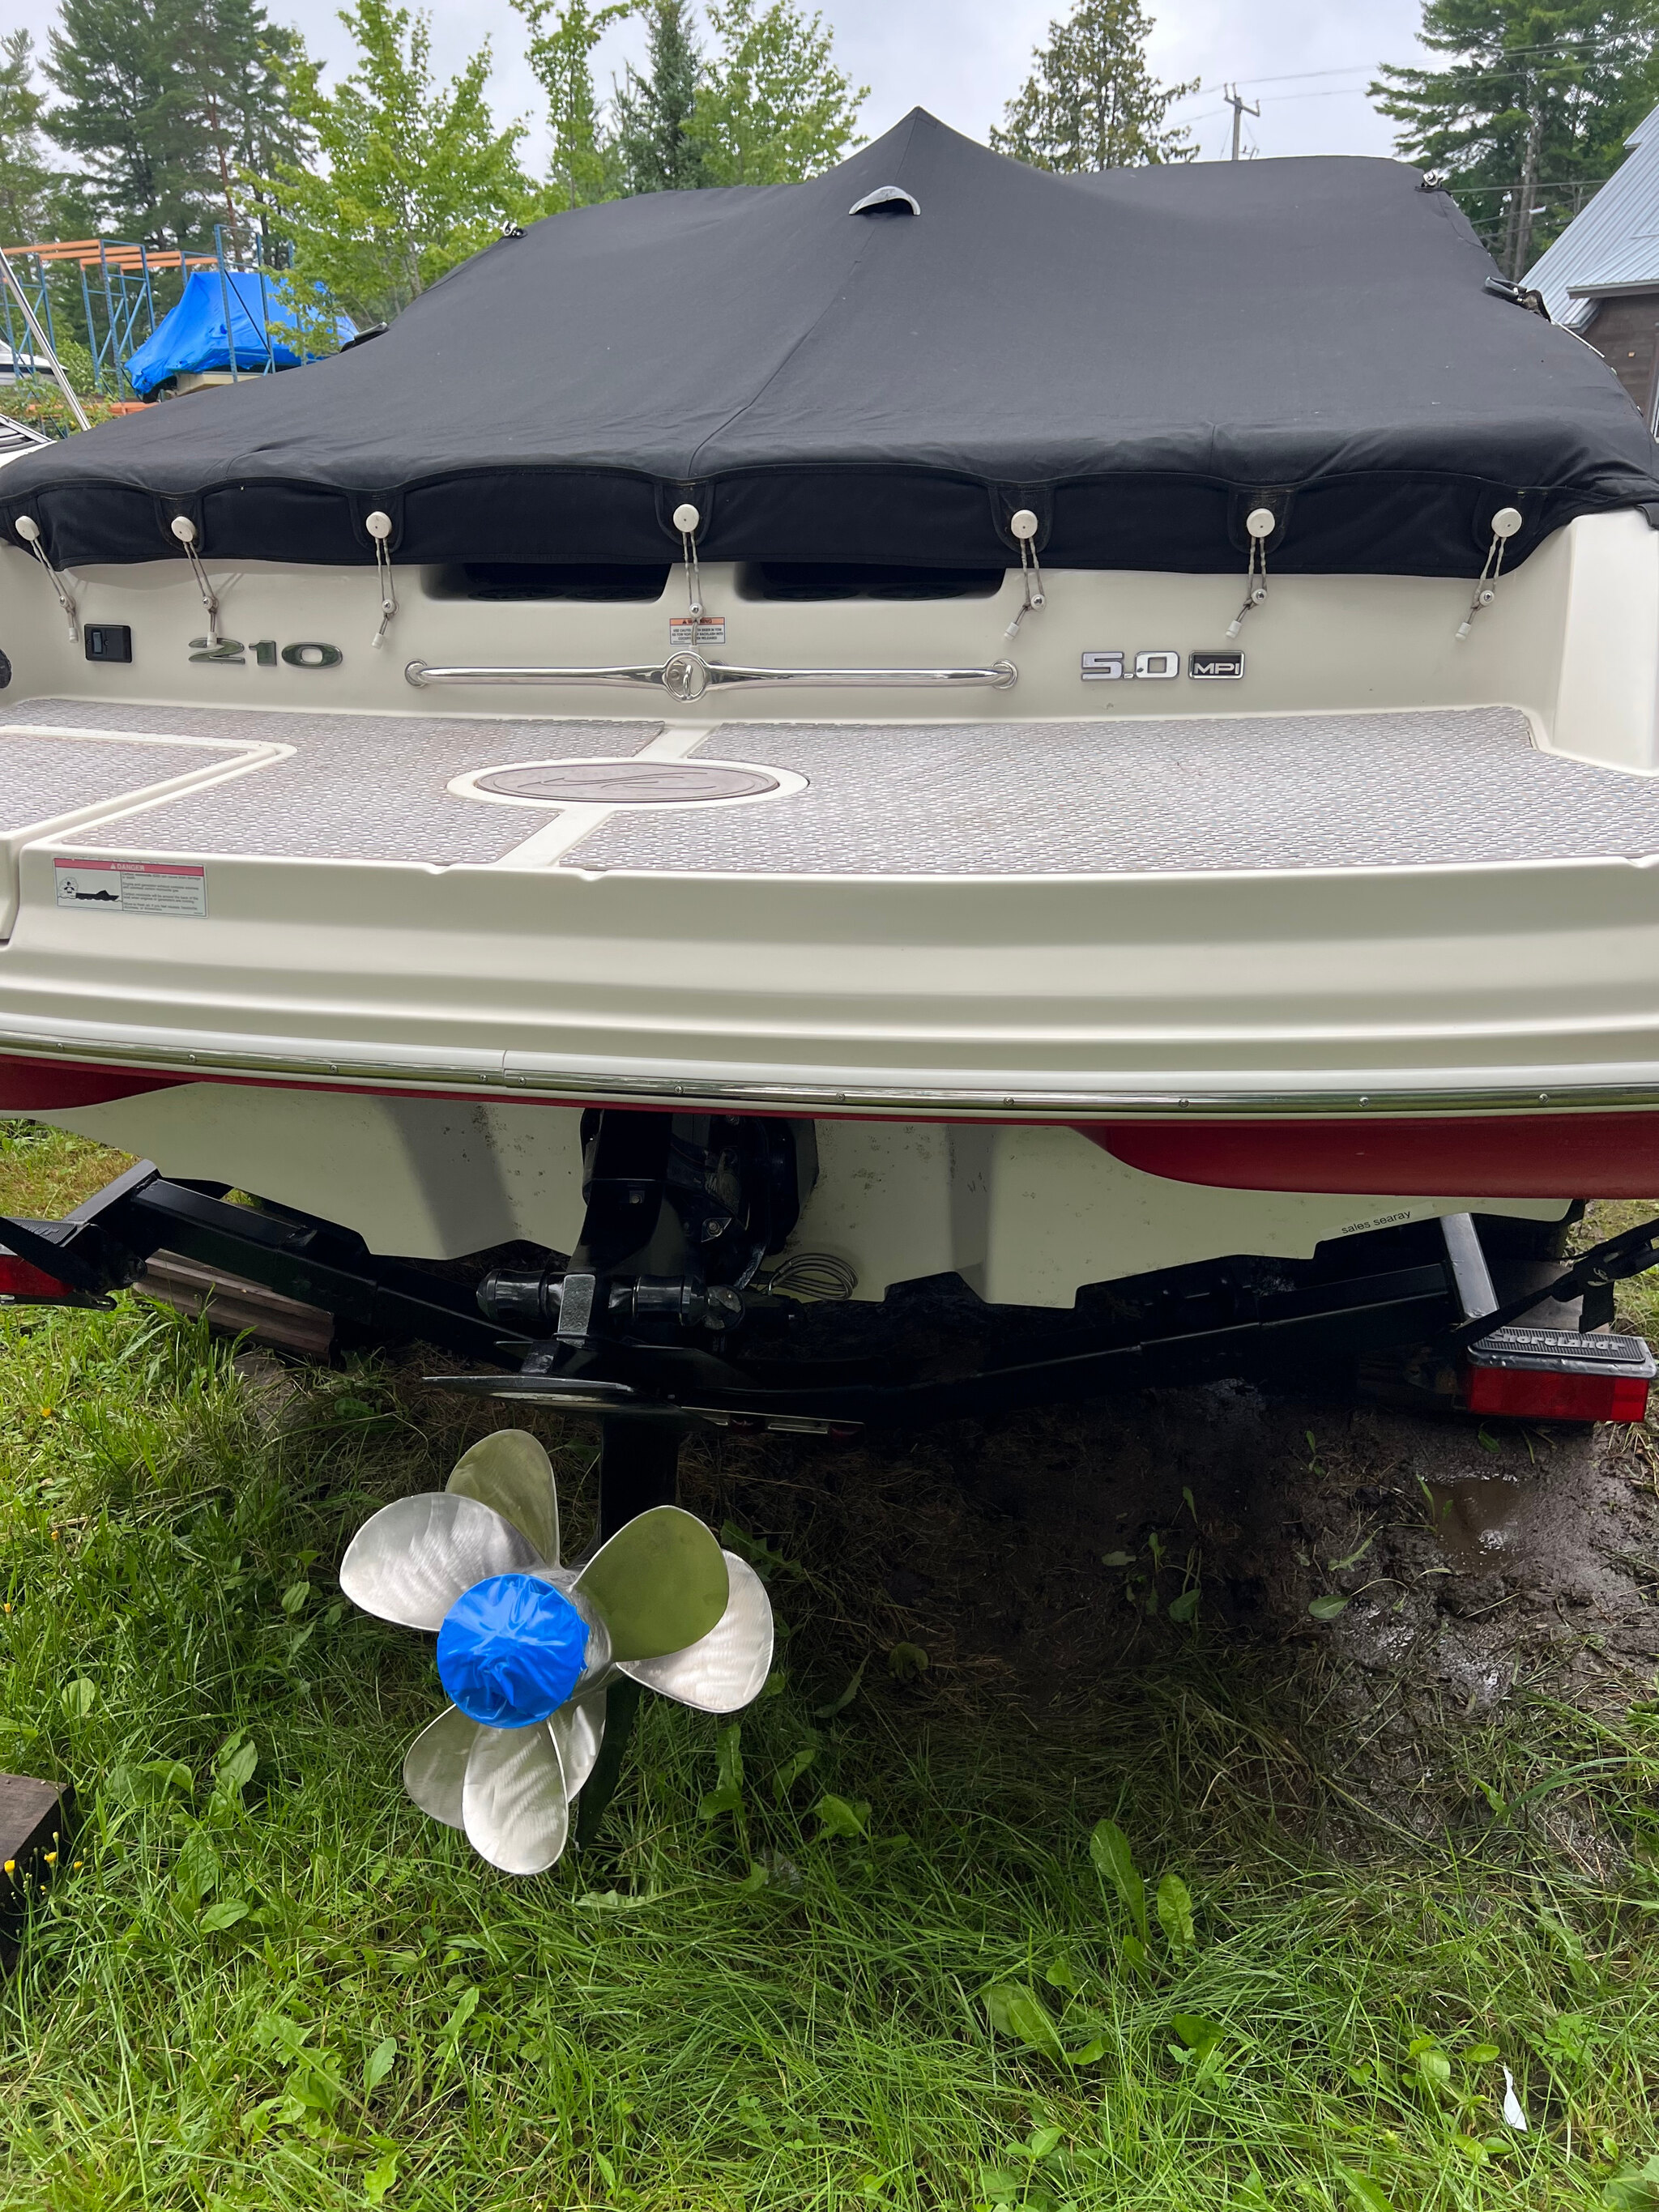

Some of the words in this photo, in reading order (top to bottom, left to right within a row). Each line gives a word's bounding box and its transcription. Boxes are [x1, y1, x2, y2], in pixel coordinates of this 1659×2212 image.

[188, 637, 343, 670] 210
[1081, 650, 1180, 681] 5.0
[1194, 662, 1240, 676] MPI
[117, 863, 145, 872] DANGER
[1341, 1221, 1371, 1234] sales
[1373, 1211, 1411, 1226] searay
